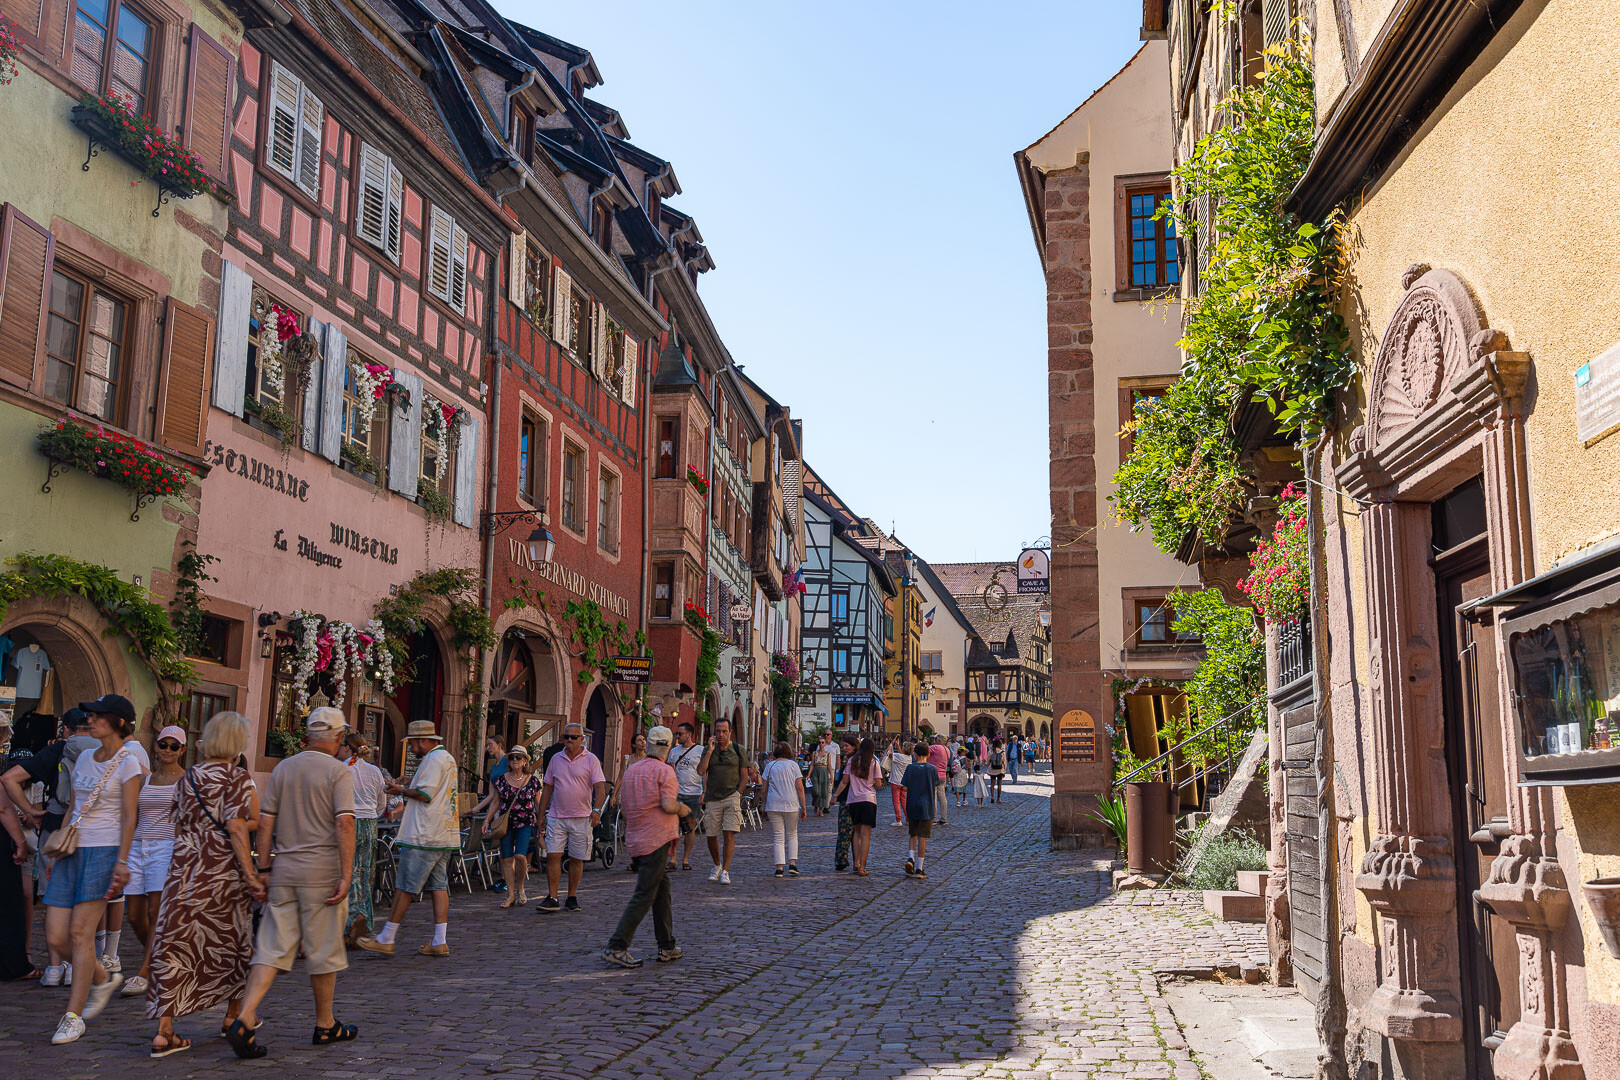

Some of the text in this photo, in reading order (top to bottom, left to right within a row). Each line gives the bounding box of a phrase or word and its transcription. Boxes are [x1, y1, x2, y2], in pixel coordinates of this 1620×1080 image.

[203, 439, 310, 503] ESTAURANT
[273, 528, 342, 570] La Diligence
[330, 521, 398, 565] WINSTUB
[508, 537, 629, 619] VINS BERNARD SCHWACH
[614, 667, 649, 675] Dégustation
